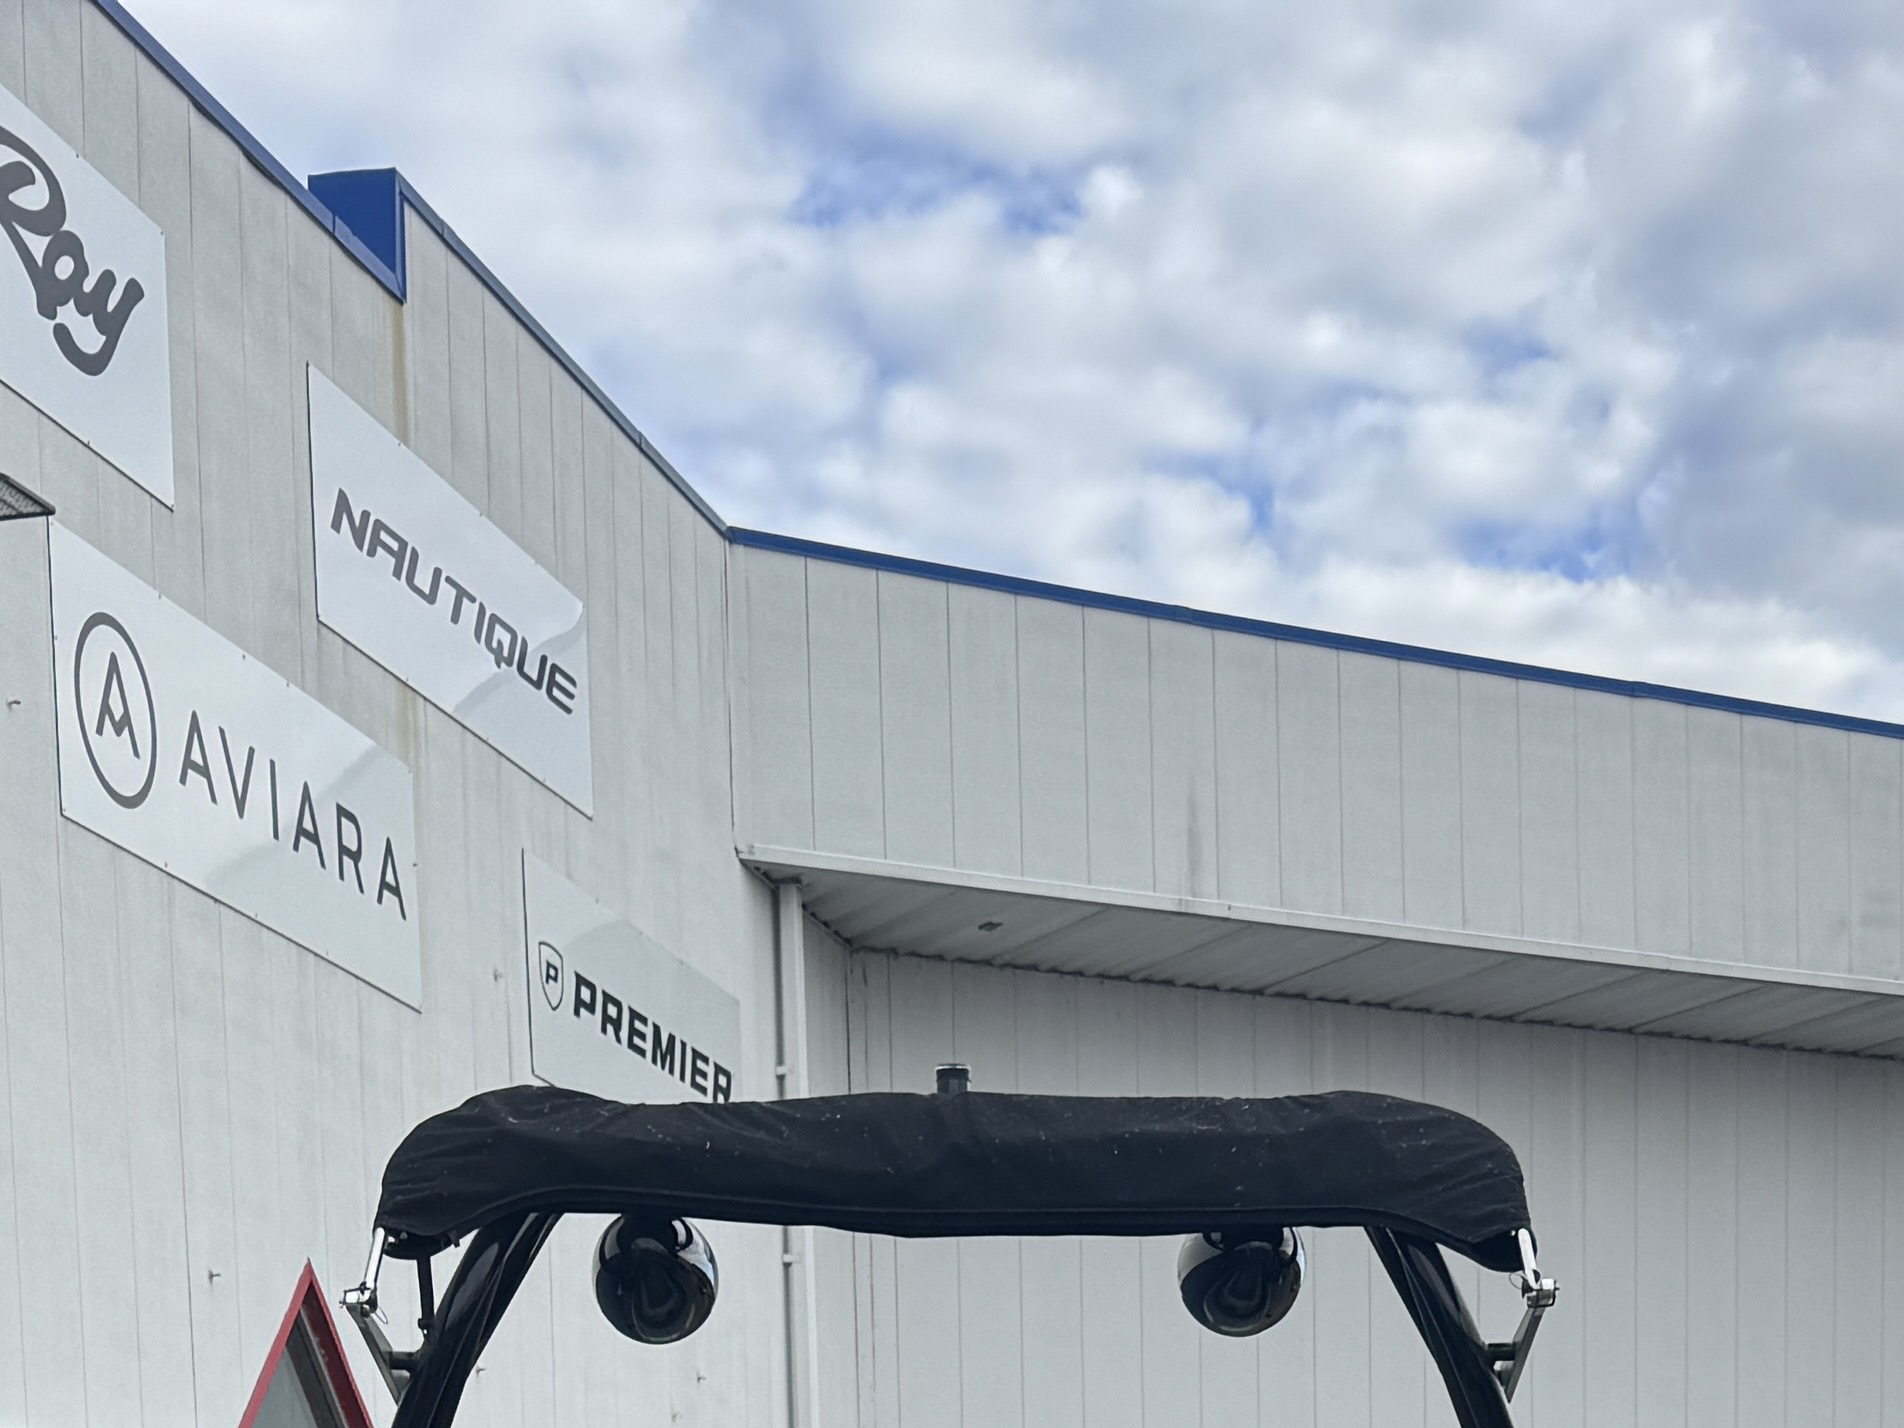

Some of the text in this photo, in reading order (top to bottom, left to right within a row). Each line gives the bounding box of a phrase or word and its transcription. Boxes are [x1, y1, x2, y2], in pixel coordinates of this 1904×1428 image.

[330, 488, 577, 716] NAUTIQUE
[179, 709, 407, 921] AVIARA
[573, 969, 732, 1104] PREMIER
